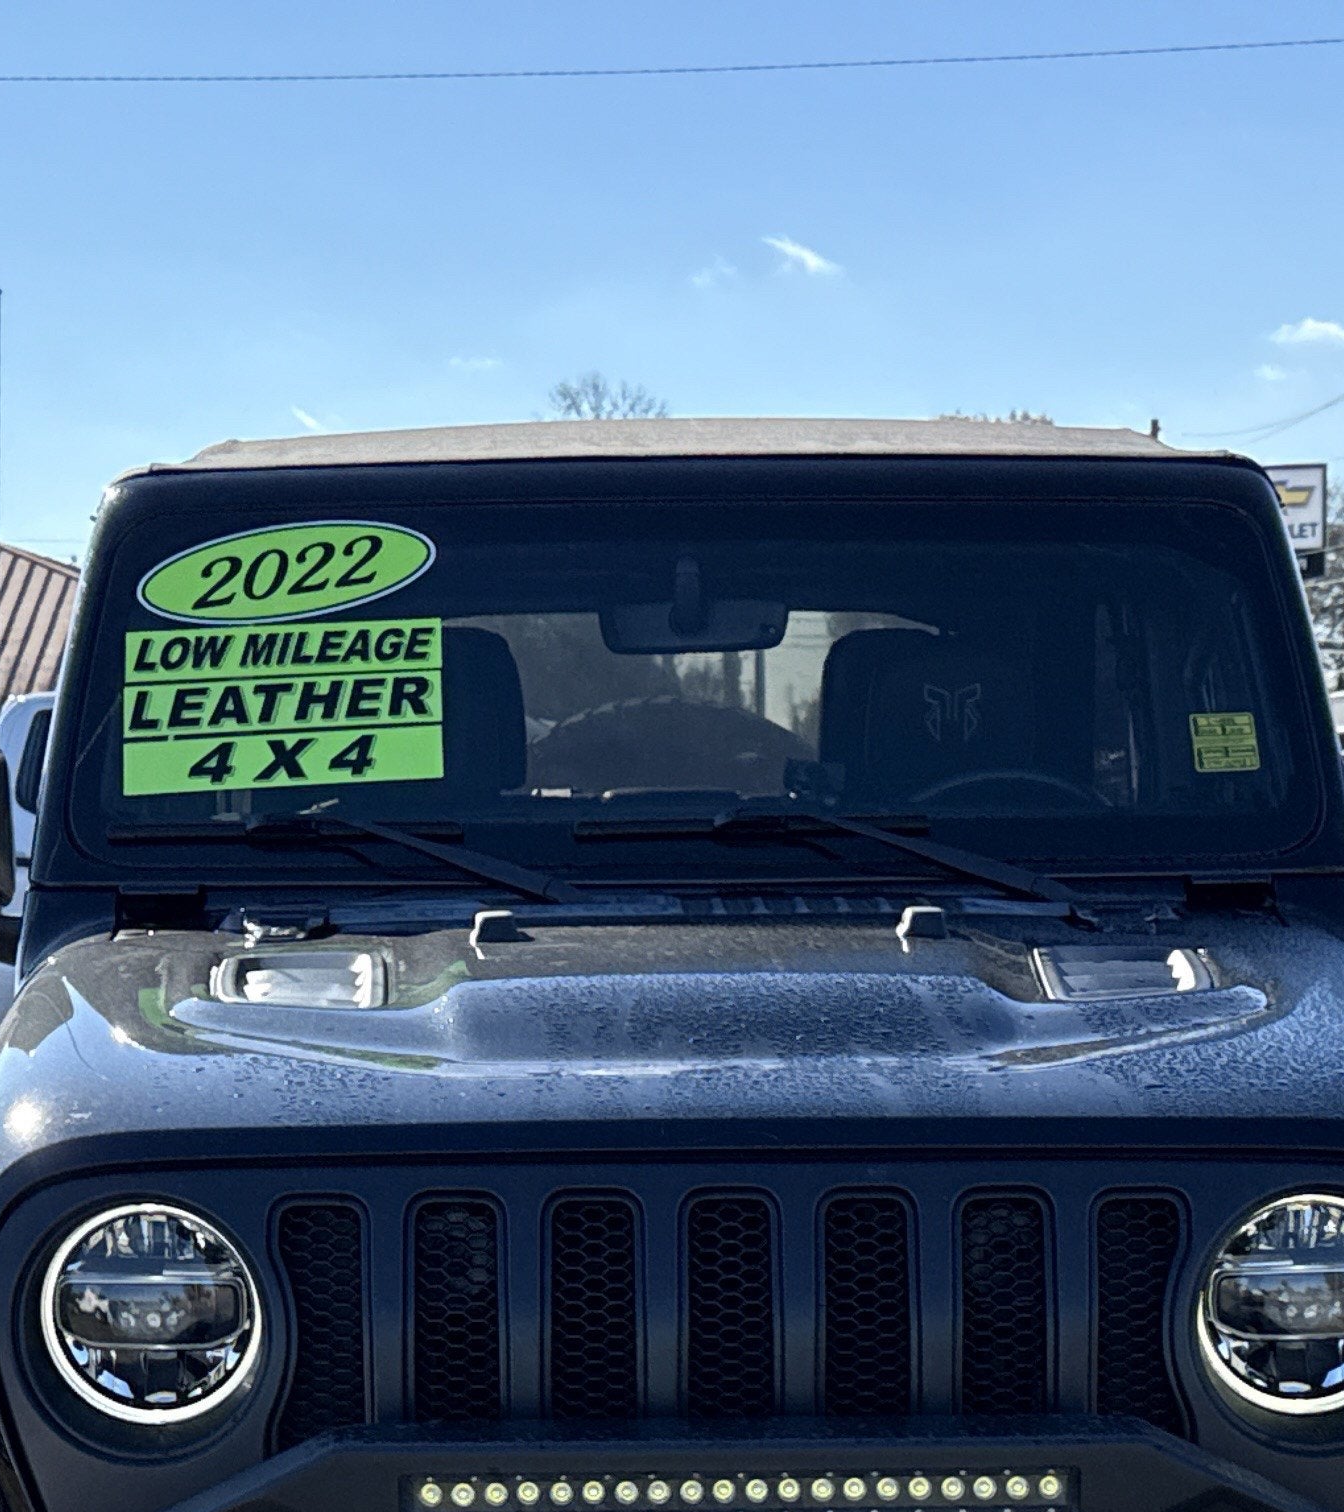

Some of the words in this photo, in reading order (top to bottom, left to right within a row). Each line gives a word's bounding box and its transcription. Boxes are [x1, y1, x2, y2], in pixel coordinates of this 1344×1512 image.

[191, 534, 384, 611] 2022
[133, 633, 233, 673] LOW
[239, 627, 435, 670] MILEAGE
[128, 676, 435, 733] LEATHER
